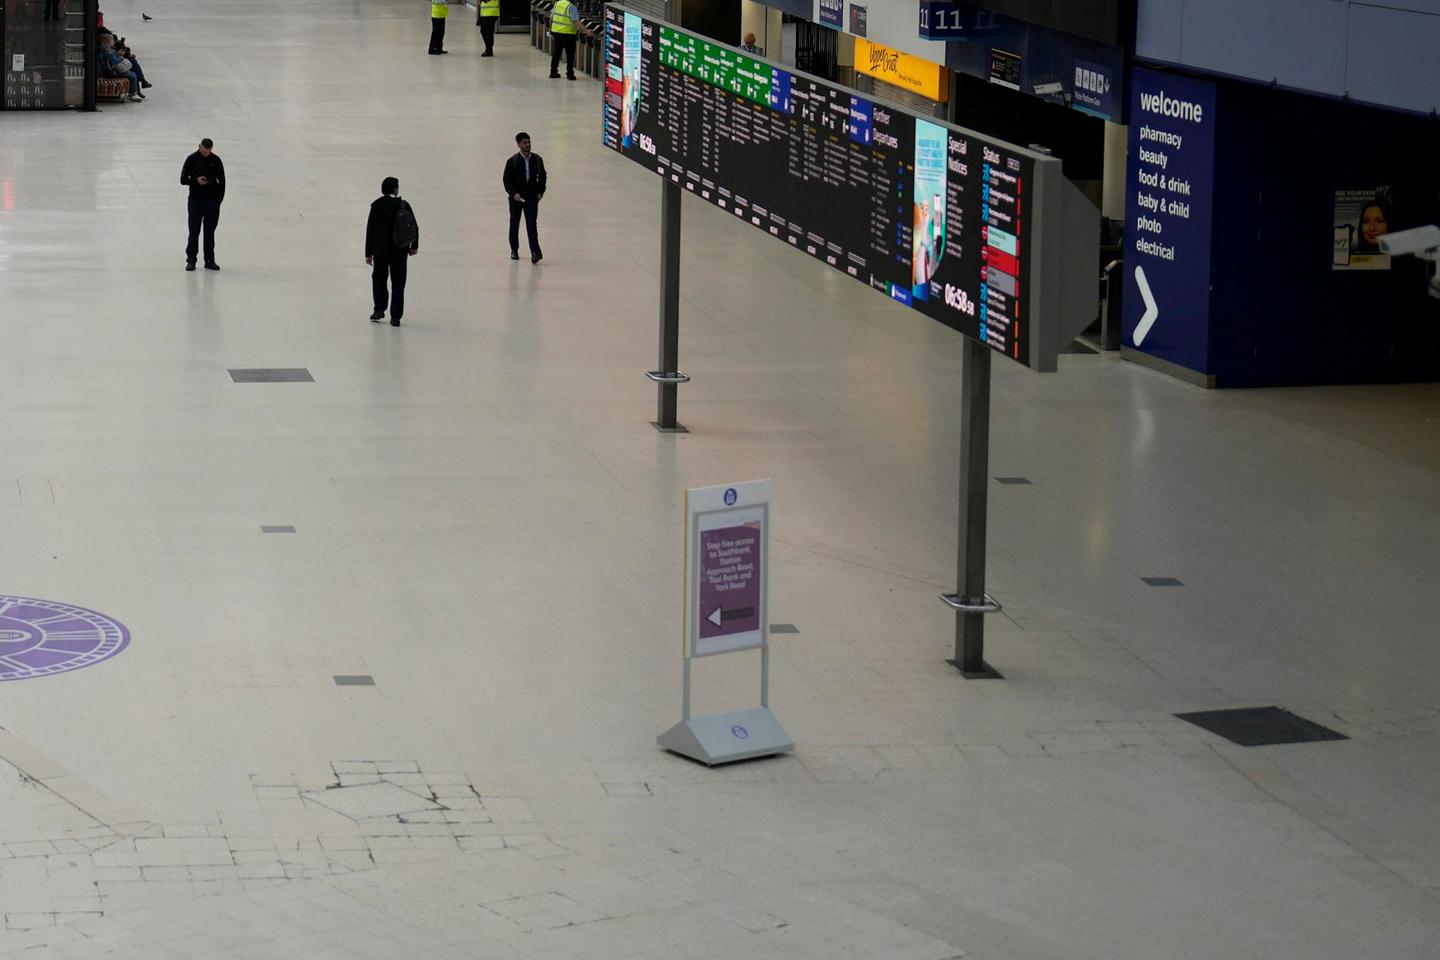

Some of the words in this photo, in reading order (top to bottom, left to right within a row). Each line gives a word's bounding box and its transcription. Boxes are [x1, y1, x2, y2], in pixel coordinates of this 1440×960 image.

[920, 8, 929, 29] 11
[935, 10, 963, 30] 11
[1140, 90, 1203, 123] welcome
[1140, 125, 1182, 150] pharmacy
[1139, 146, 1168, 169] beauty
[1138, 168, 1158, 187] food
[1159, 174, 1166, 190] &
[1168, 176, 1191, 195] drink
[1138, 191, 1159, 213] baby
[1160, 198, 1167, 213] &
[1168, 201, 1190, 219] child
[1137, 215, 1162, 234] photo
[1136, 237, 1175, 261] electrical
[944, 283, 968, 311] 06:58
